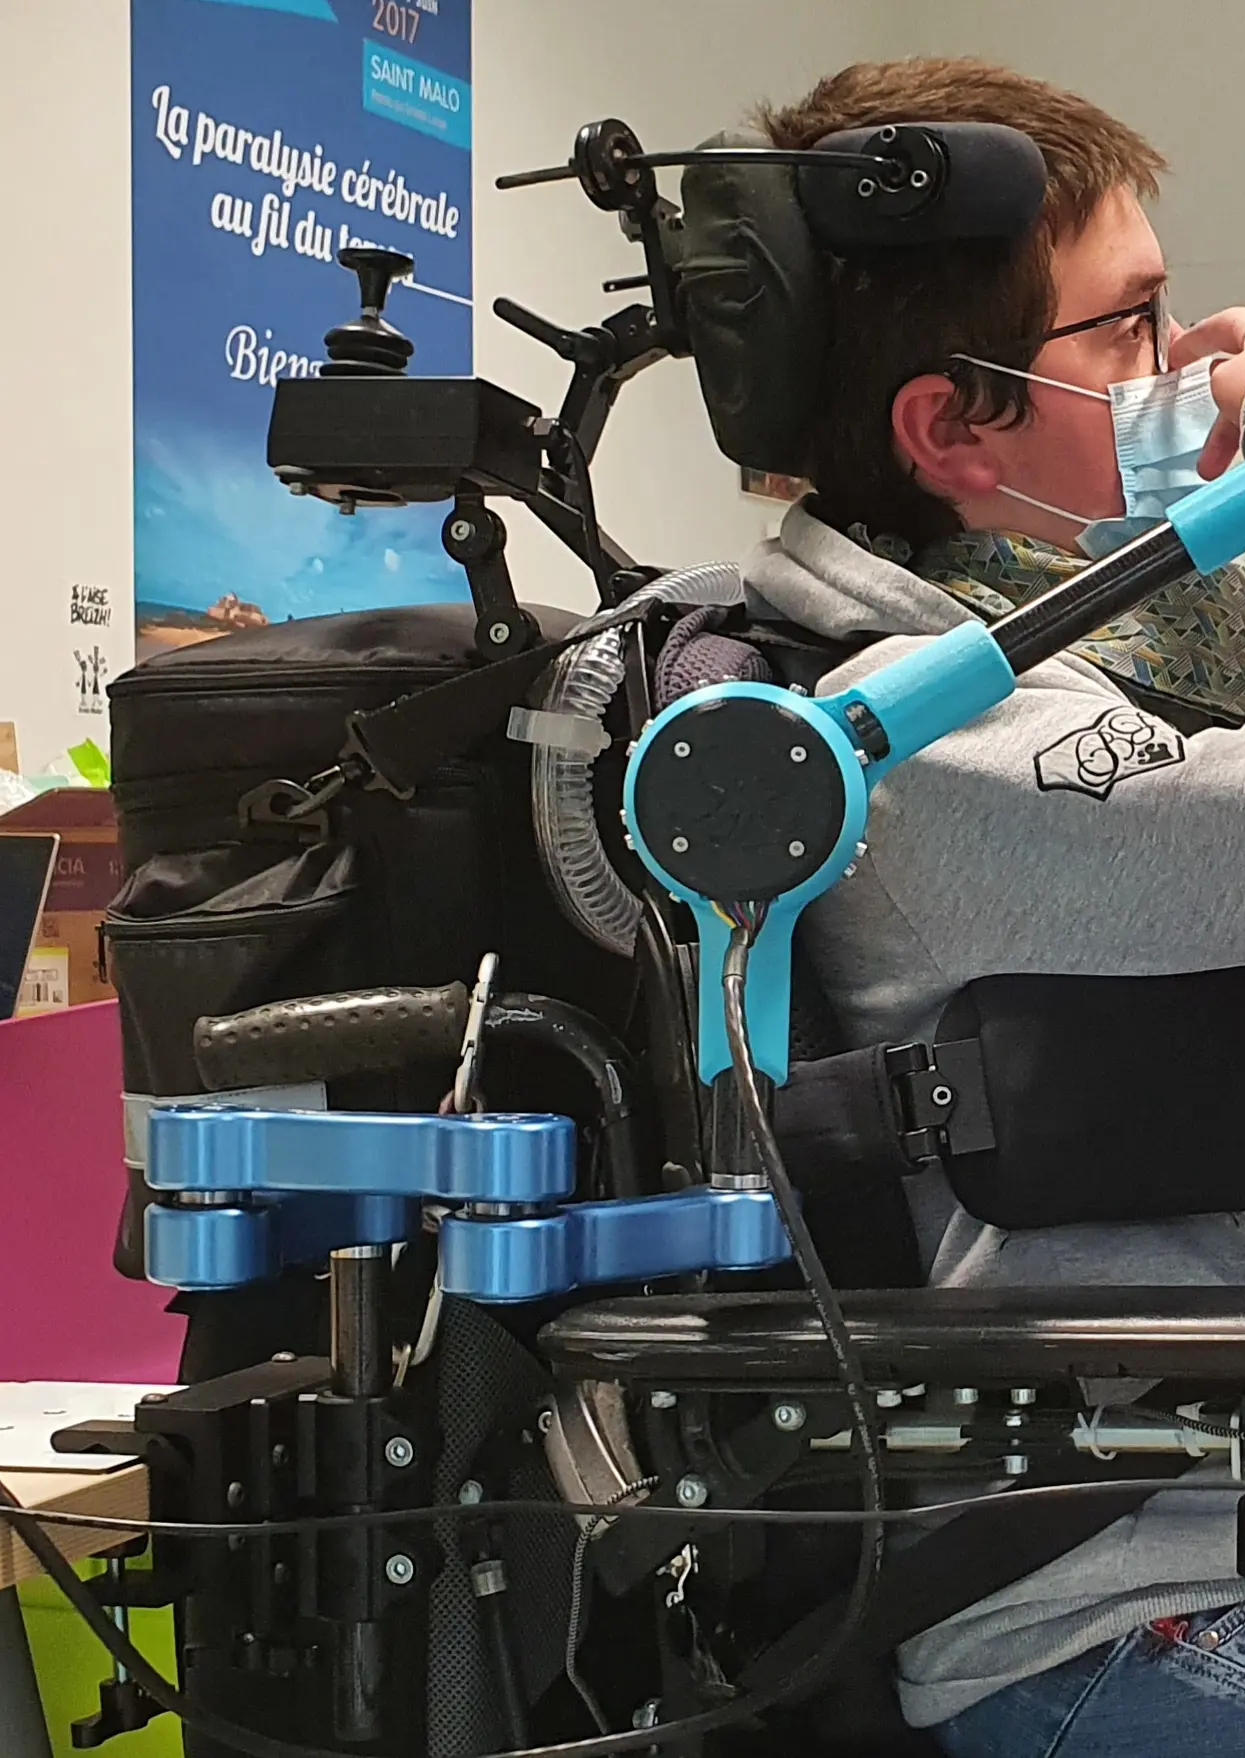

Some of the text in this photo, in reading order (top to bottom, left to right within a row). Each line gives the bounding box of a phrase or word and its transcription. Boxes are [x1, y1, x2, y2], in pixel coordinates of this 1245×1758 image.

[372, 0, 419, 43] 2017
[371, 54, 415, 94] SAINT
[419, 75, 460, 112] MALO
[151, 85, 459, 238] La paralysie cérébrale
[211, 192, 252, 237] au
[252, 193, 290, 256] fil
[294, 210, 332, 262] du
